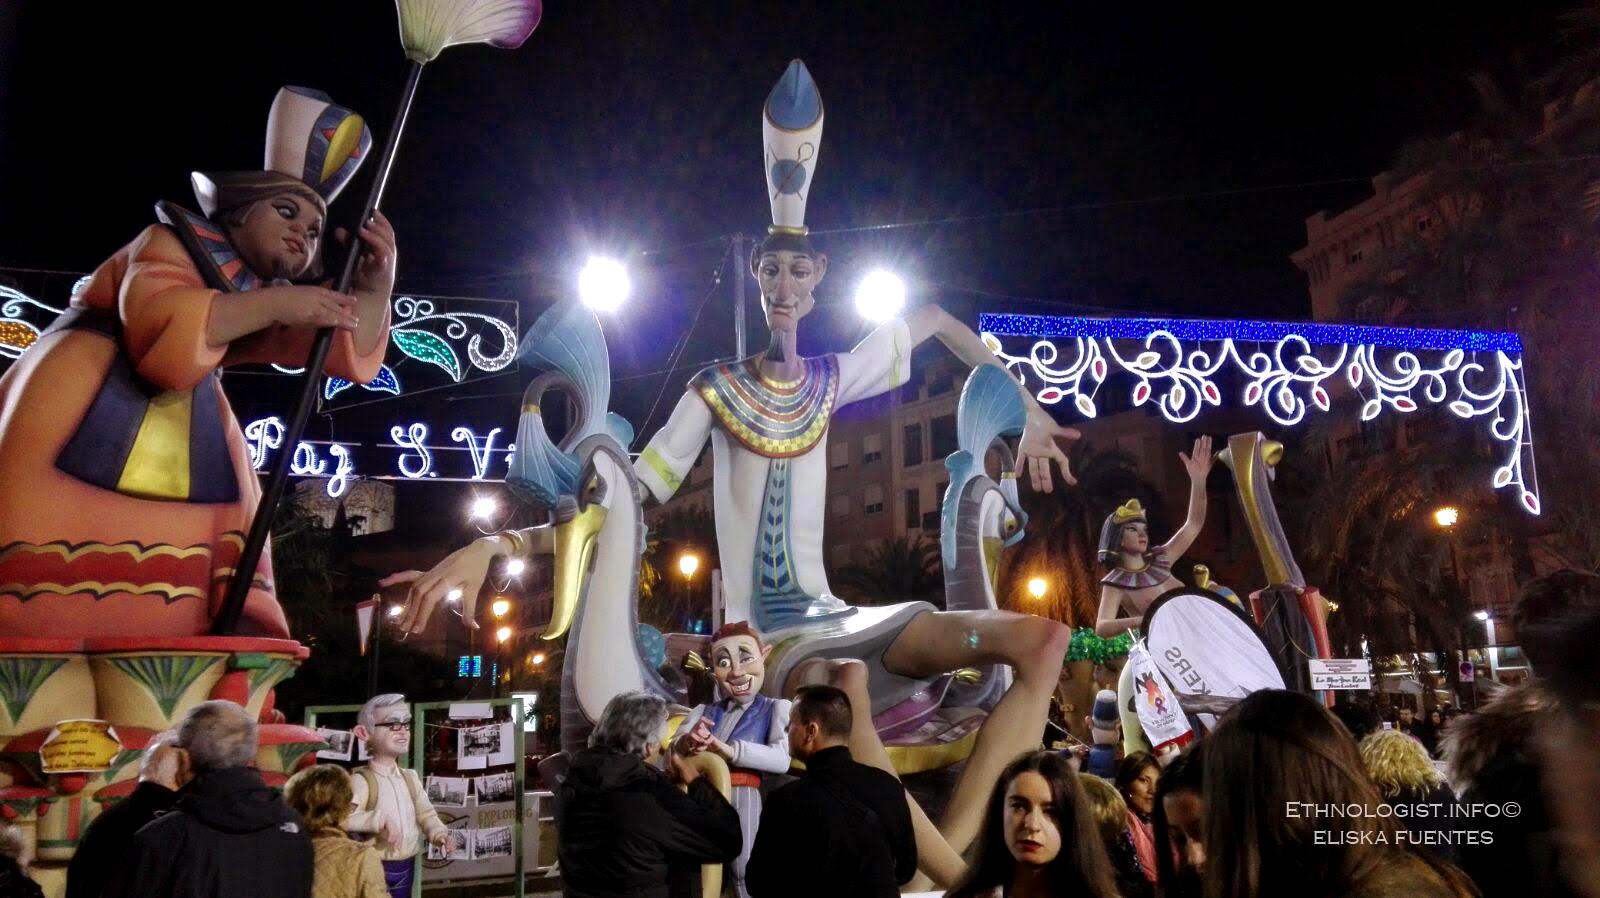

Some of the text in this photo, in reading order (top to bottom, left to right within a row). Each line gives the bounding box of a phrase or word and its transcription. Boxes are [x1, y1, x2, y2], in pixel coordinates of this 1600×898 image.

[245, 416, 517, 497] Paz S. Vi
[478, 807, 534, 821] EXPLORG
